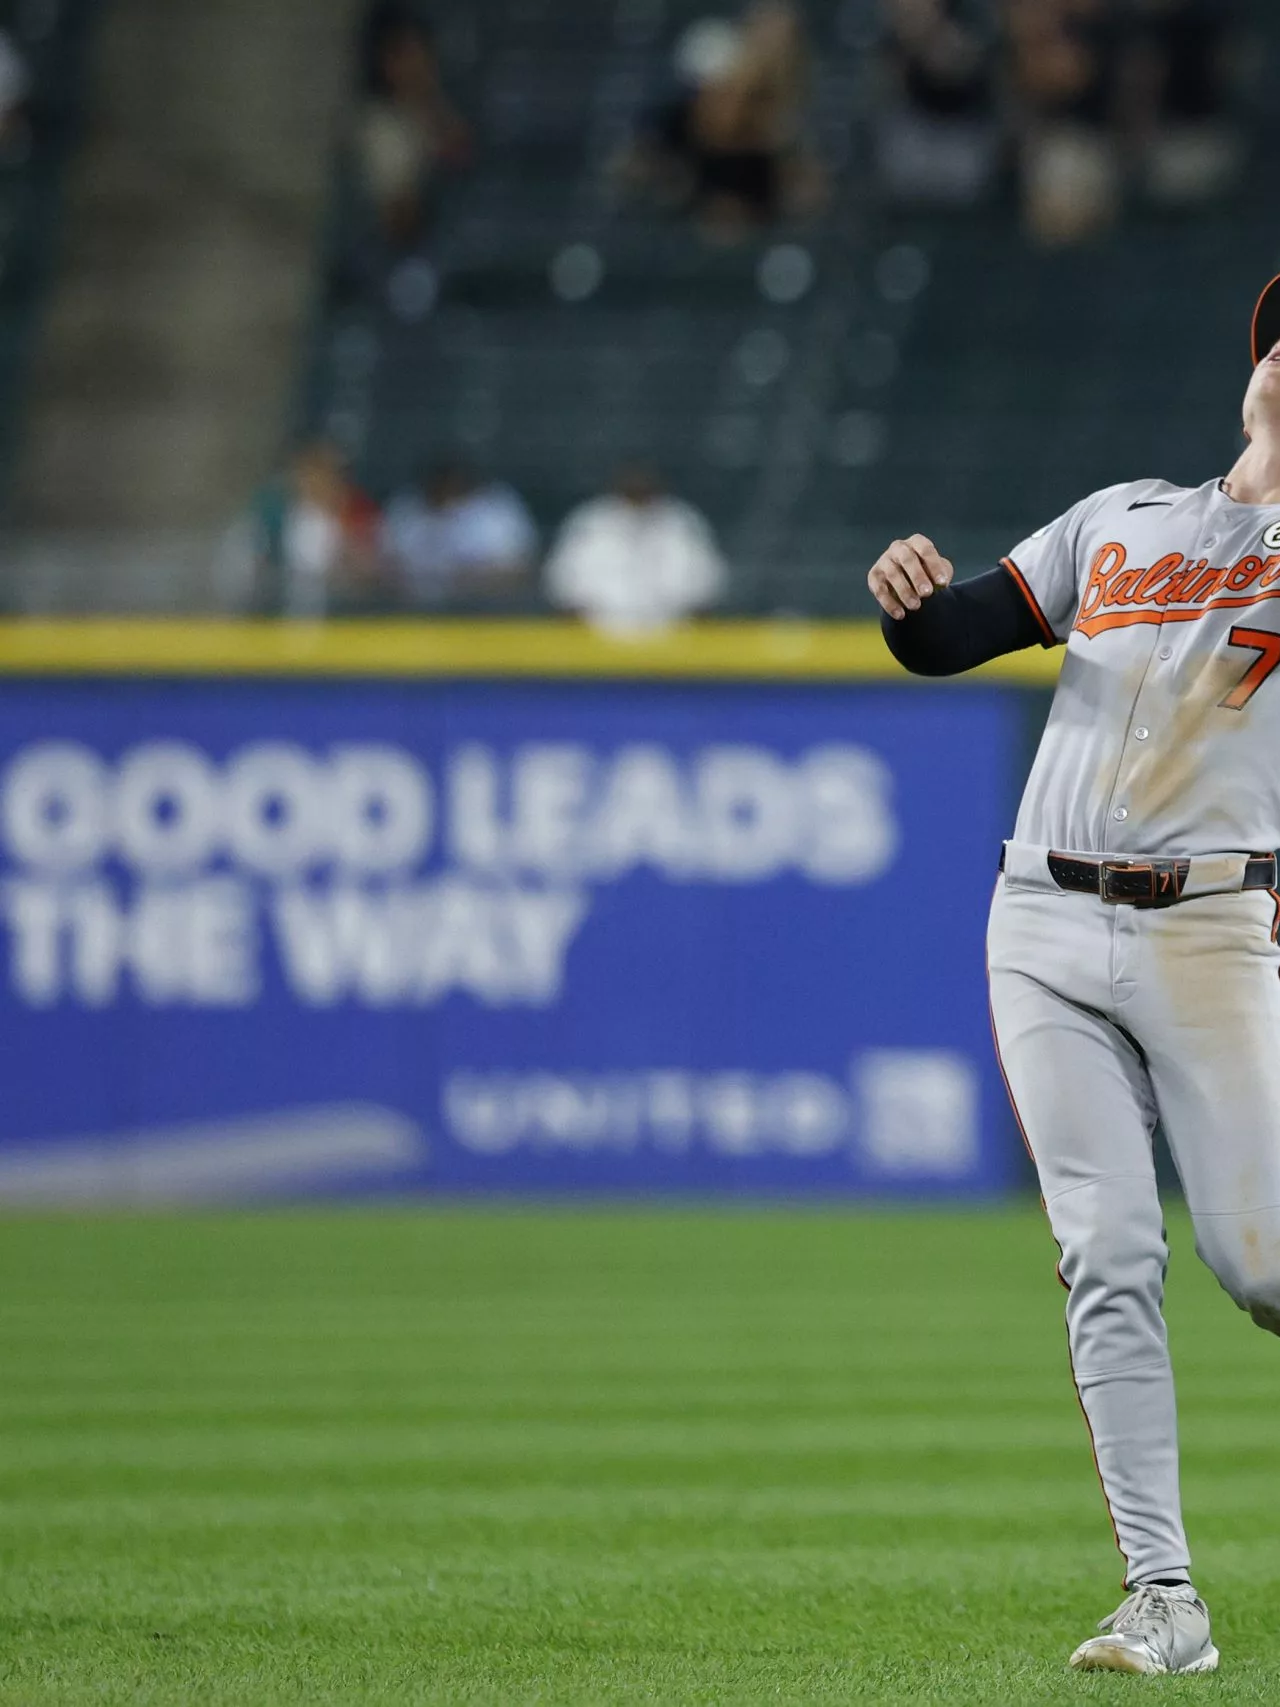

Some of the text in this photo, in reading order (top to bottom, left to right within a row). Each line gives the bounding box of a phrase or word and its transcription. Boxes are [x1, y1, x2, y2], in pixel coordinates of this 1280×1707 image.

[3, 742, 897, 884] GOOD LEADS
[2, 880, 588, 1006] THE WAY
[1160, 872, 1169, 892] 7
